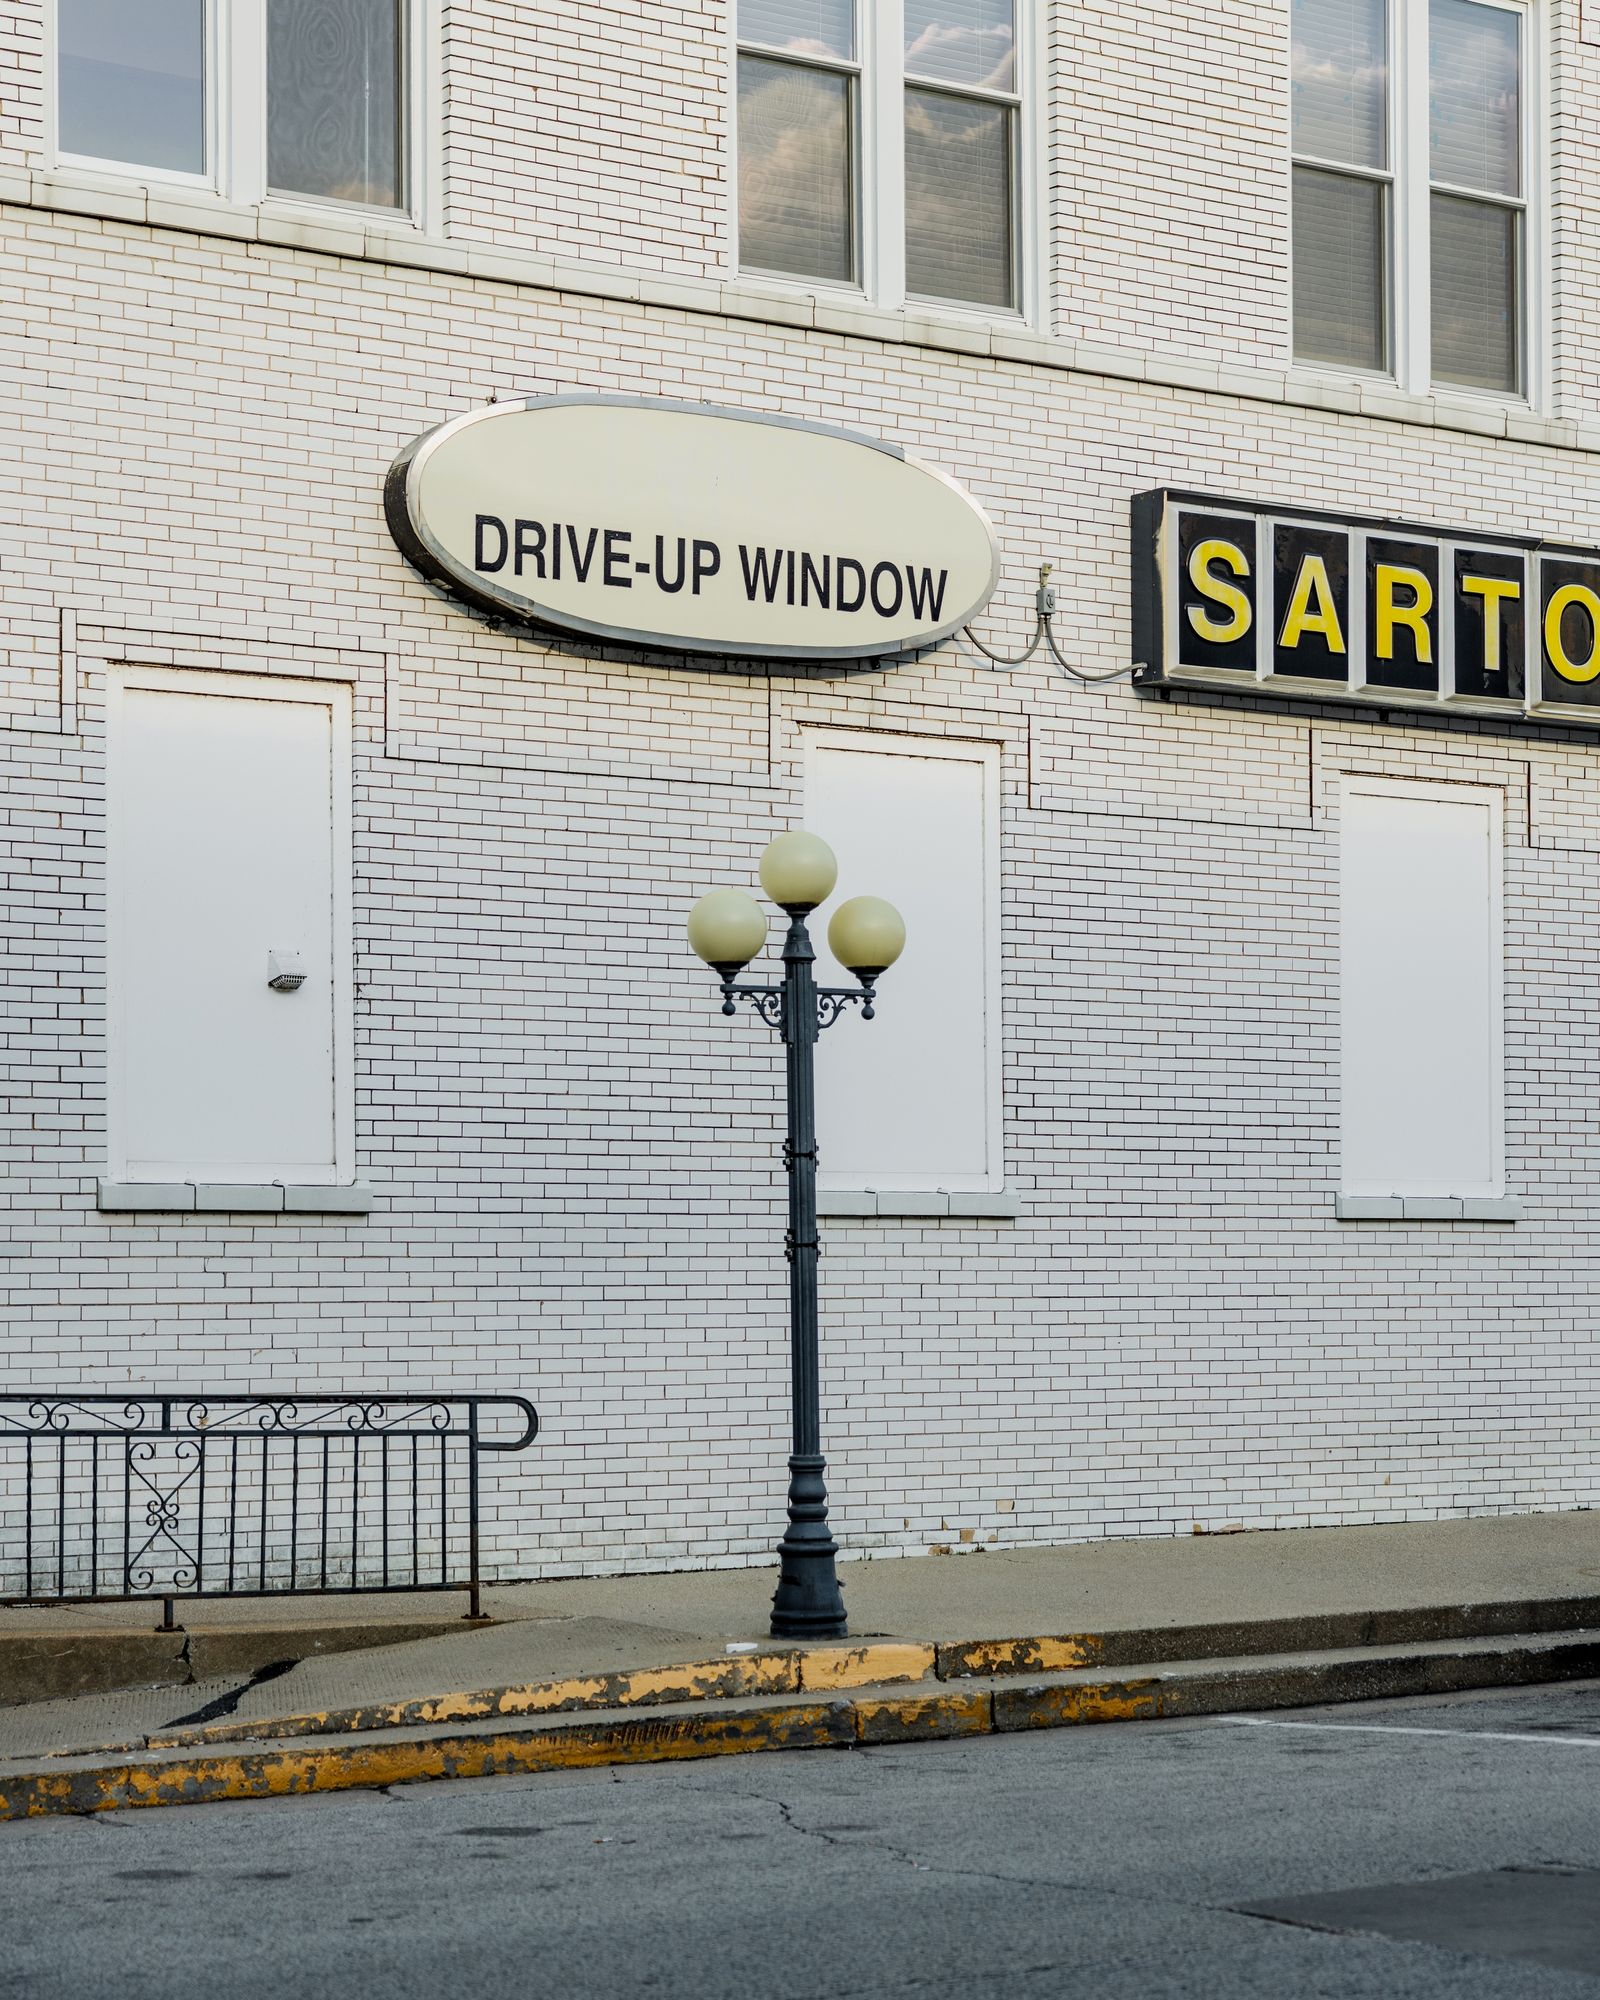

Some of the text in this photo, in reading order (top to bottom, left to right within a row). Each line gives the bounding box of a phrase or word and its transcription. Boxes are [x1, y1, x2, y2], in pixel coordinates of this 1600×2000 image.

[474, 513, 948, 622] DRIVE-UP WINDOW
[1186, 538, 1600, 682] SARTO
